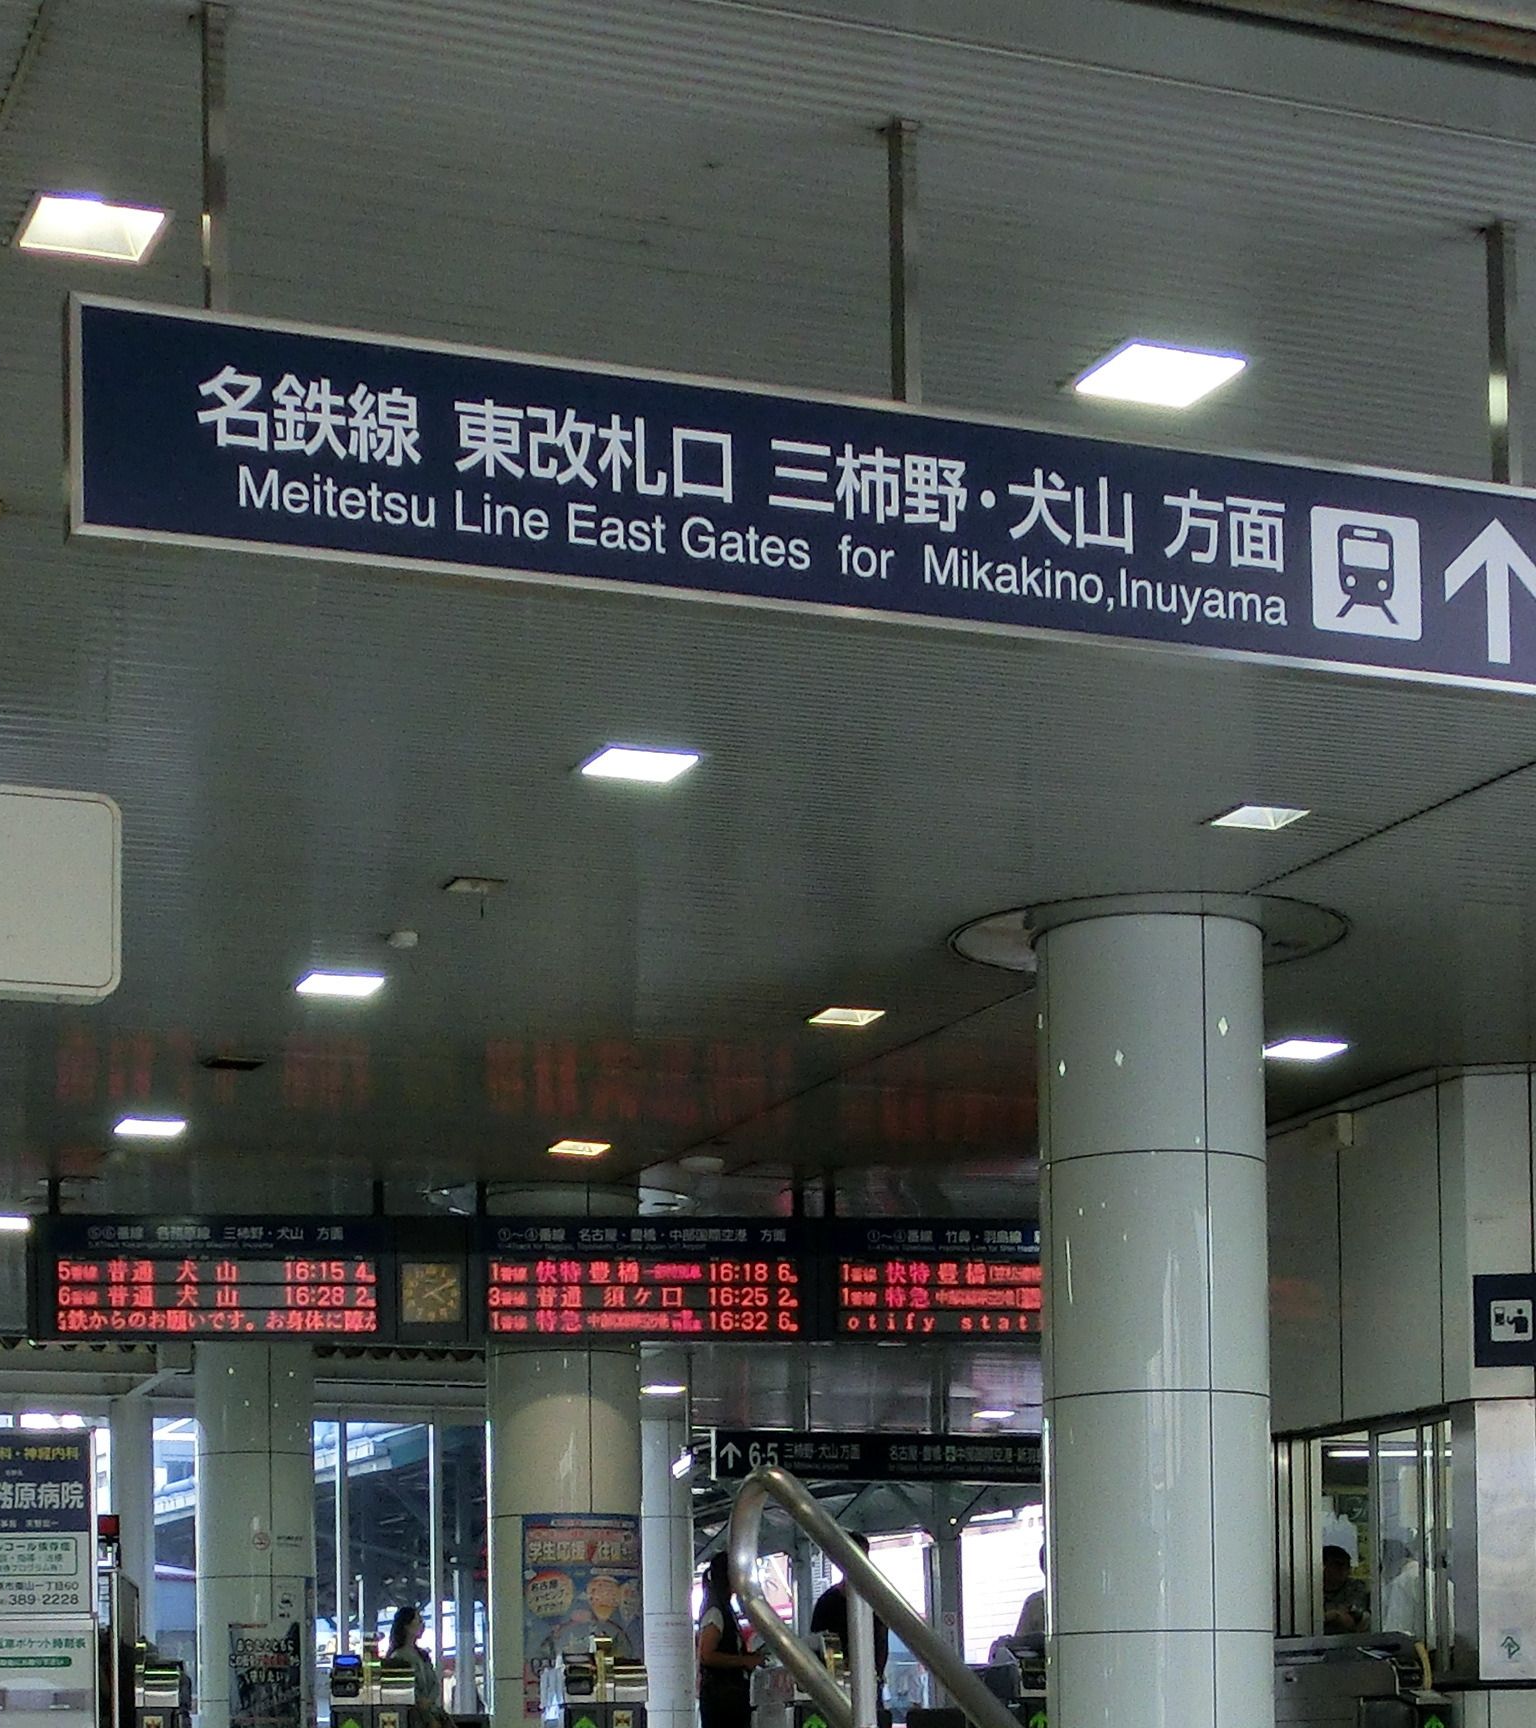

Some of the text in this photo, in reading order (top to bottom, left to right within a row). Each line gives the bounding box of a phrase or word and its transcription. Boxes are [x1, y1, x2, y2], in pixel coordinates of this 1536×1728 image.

[197, 365, 1286, 574] 名鉄線 東改札口 三柿野・犬山 方面
[238, 465, 436, 529] Meitetsu
[454, 490, 550, 541] Line
[567, 503, 666, 554] East
[681, 516, 810, 571] Gates
[838, 526, 895, 580] for
[108, 1260, 154, 1283] 普通
[284, 1260, 345, 1283] 16:15
[535, 1261, 582, 1284] 快特
[589, 1261, 640, 1284] 豊橋
[709, 1261, 768, 1284] 16:18
[885, 1262, 931, 1285] 快特
[937, 1262, 987, 1285] 豊橋
[108, 1285, 154, 1308] 普通
[284, 1285, 345, 1308] 16:28
[536, 1286, 582, 1308] 普通
[709, 1286, 769, 1308] 16:25
[885, 1287, 931, 1308] 特急
[535, 1310, 582, 1332] 特急
[709, 1310, 768, 1332] 16:32
